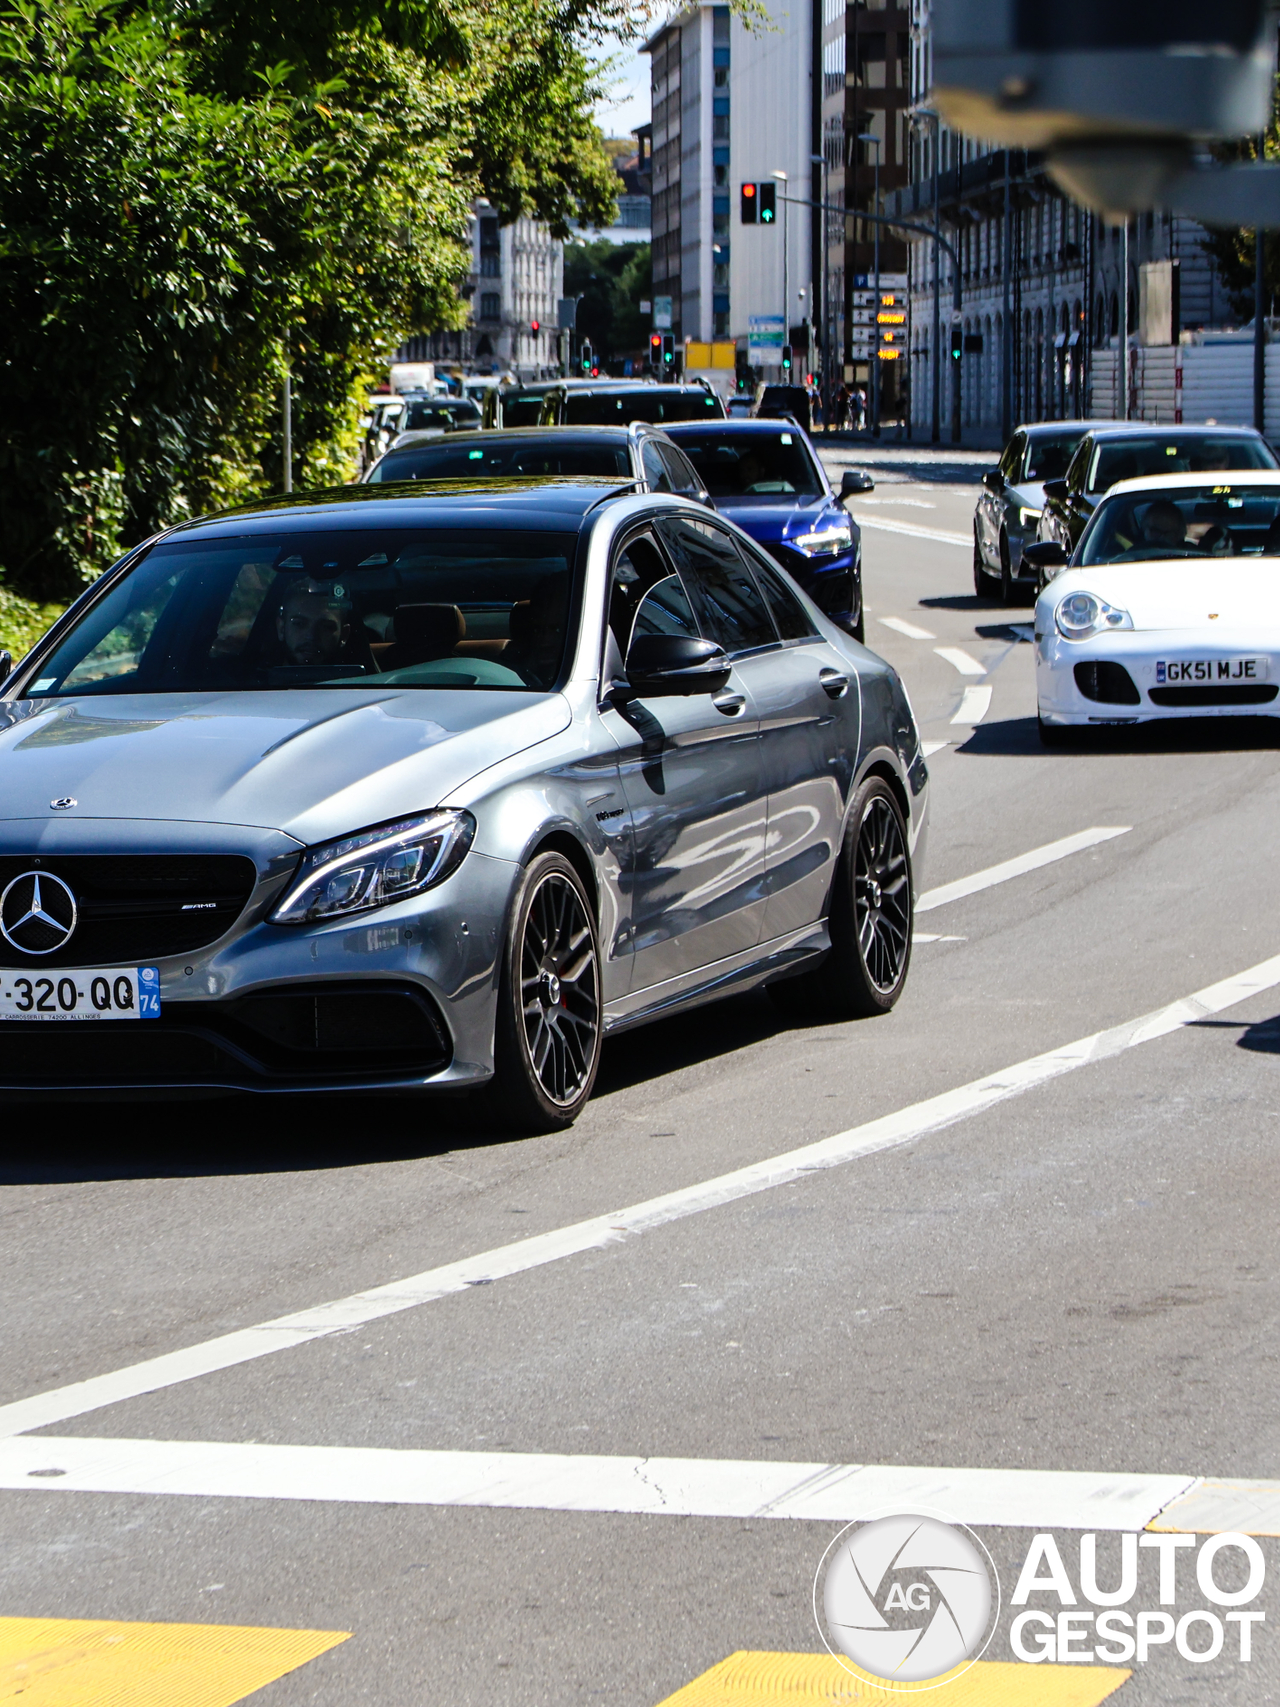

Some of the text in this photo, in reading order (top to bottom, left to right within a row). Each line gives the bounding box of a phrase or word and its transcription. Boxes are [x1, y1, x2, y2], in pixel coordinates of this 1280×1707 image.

[1167, 661, 1256, 680] GK51 MJE
[140, 994, 160, 1012] 74
